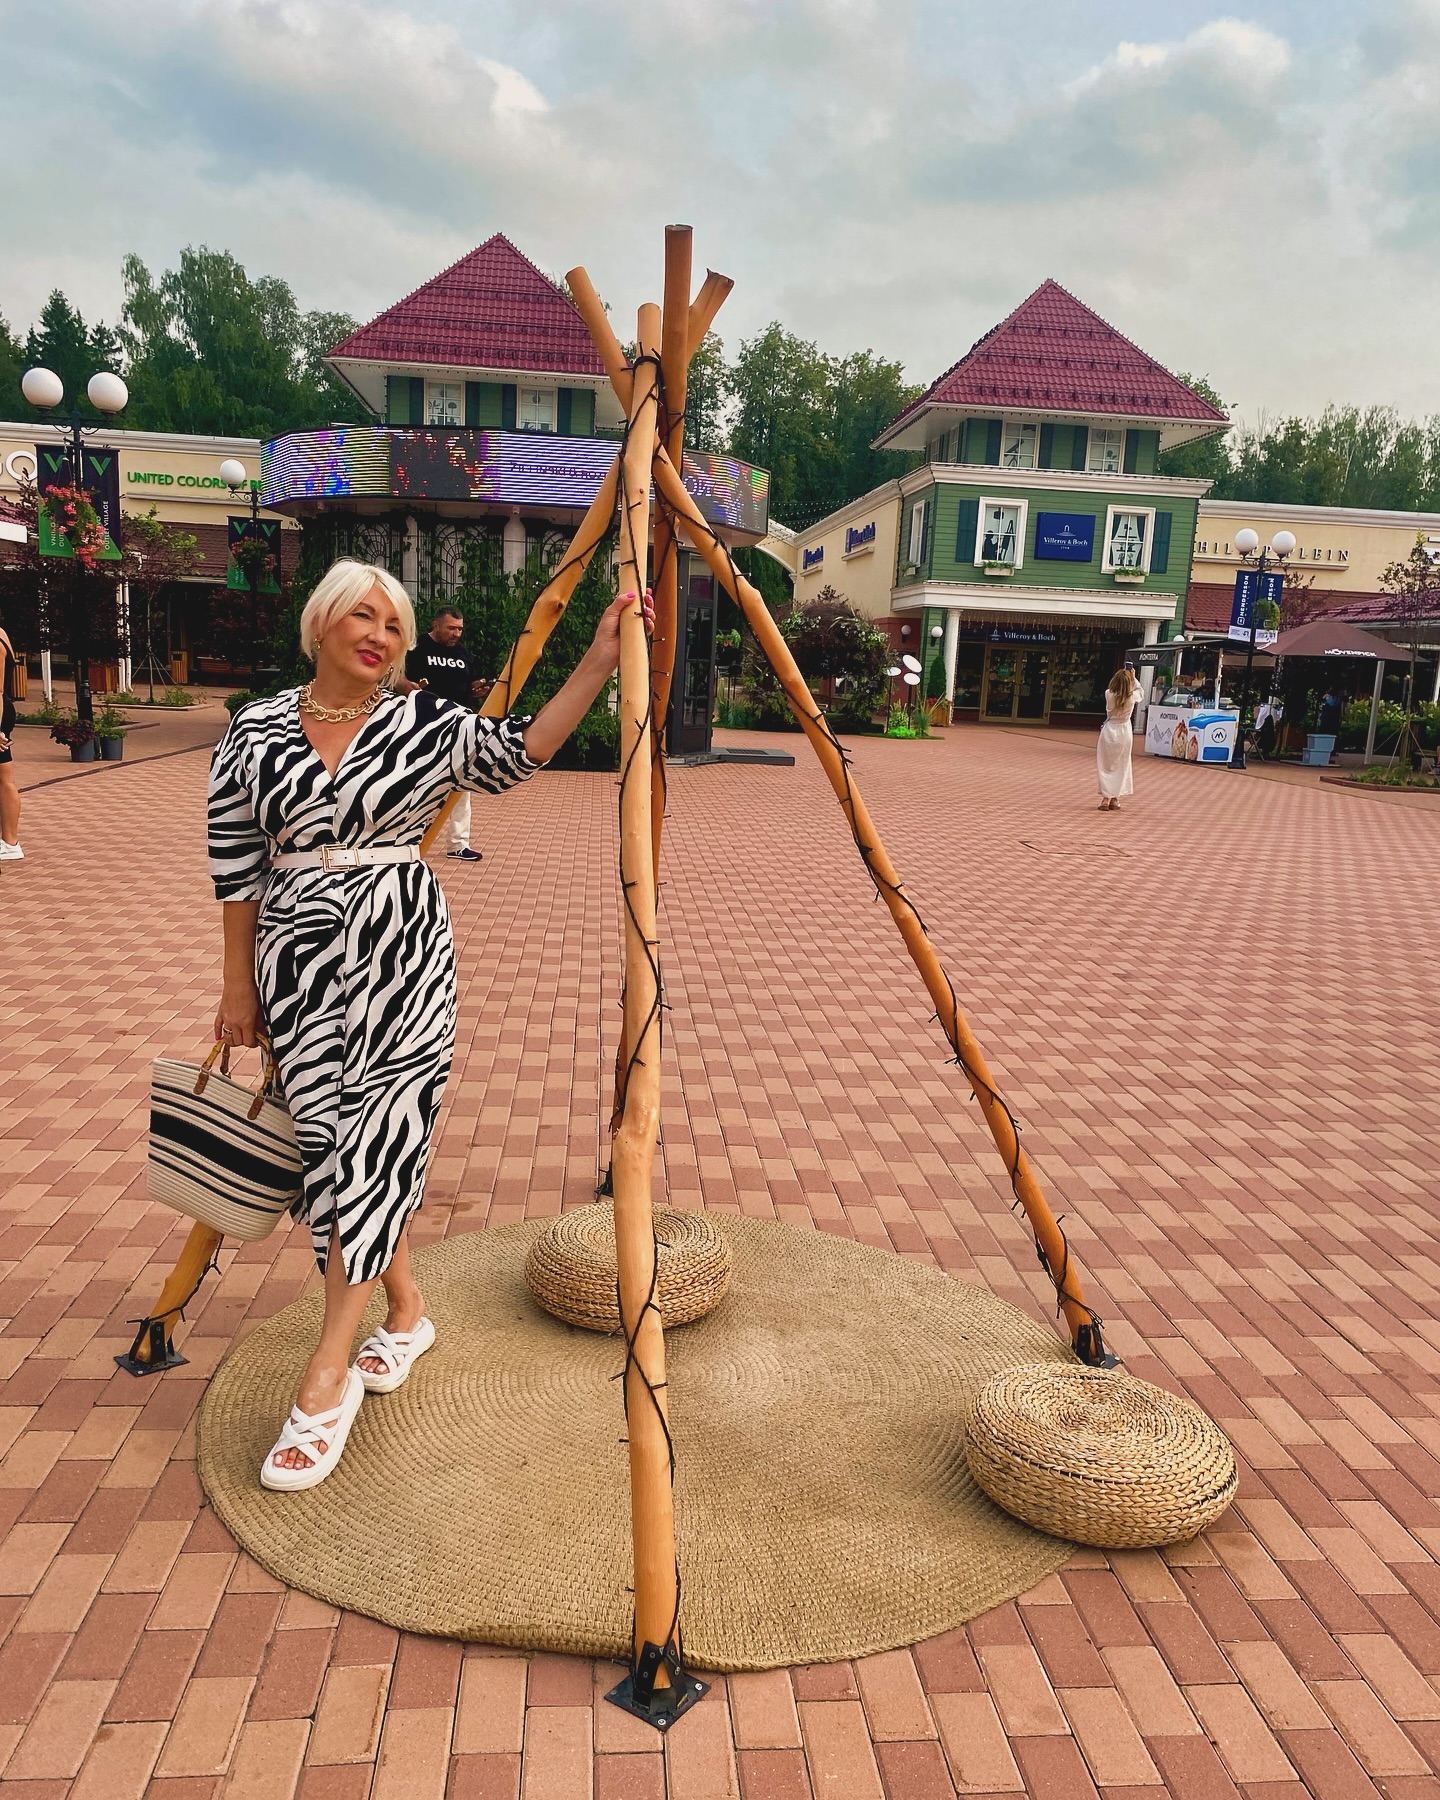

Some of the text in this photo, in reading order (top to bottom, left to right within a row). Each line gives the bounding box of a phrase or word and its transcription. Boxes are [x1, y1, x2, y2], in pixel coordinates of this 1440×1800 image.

[127, 471, 174, 485] UNITED
[177, 475, 227, 489] COLORS
[1043, 537, 1067, 545] Villeroy
[1239, 575, 1250, 617] HENDERSON
[1004, 632, 1031, 640] Villeroy
[427, 655, 466, 669] HUGO
